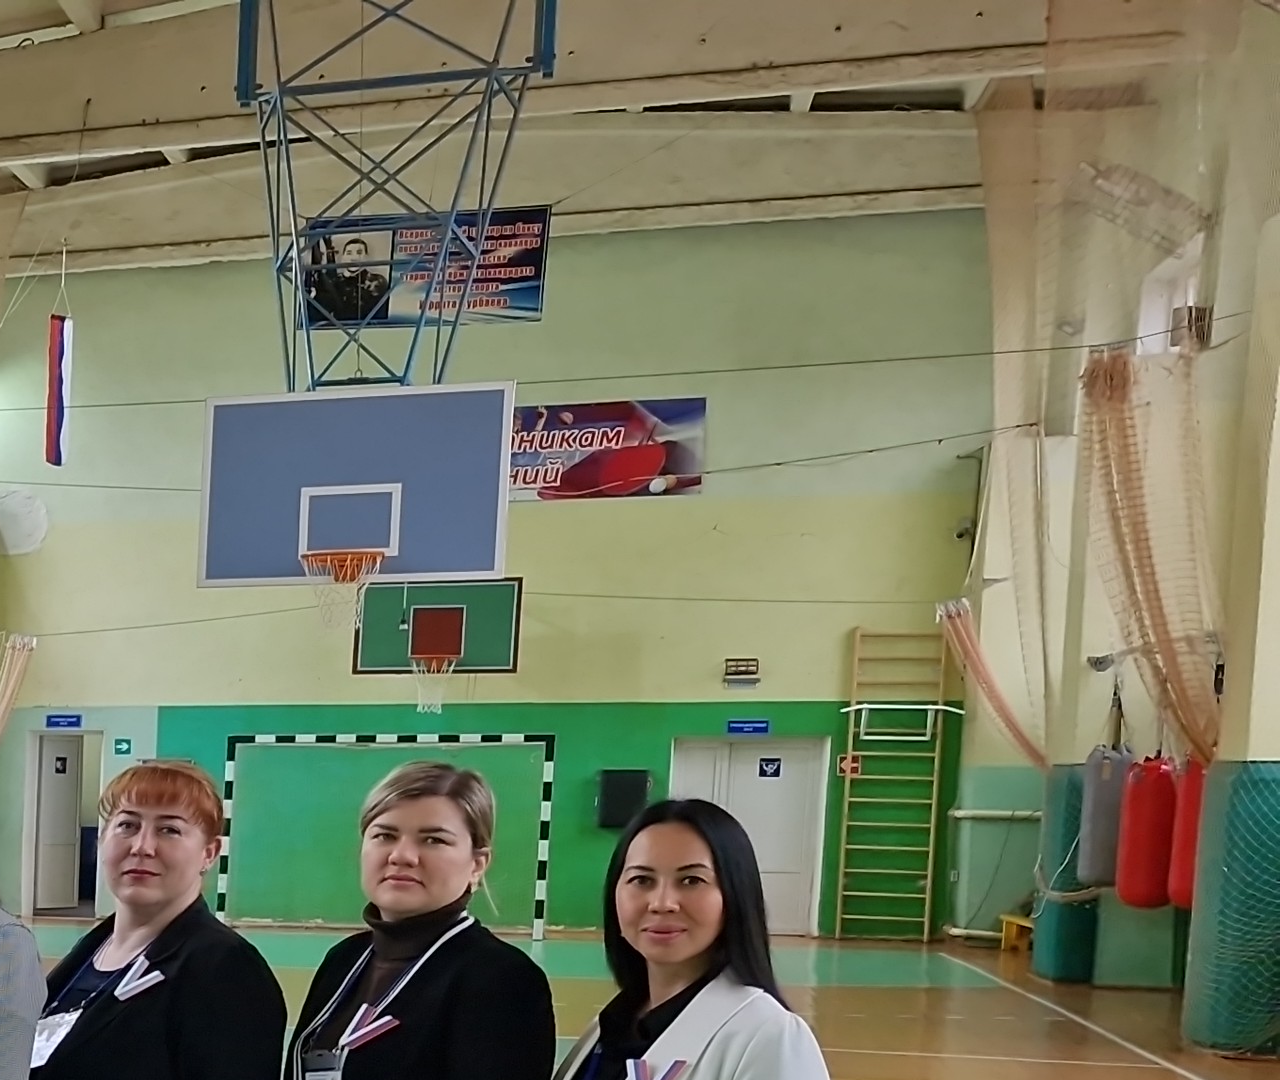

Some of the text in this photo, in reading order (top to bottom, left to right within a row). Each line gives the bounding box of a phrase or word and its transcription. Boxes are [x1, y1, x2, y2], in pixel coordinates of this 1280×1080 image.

[515, 222, 542, 235] боксу
[497, 238, 541, 250] кавалера
[511, 427, 625, 453] никам
